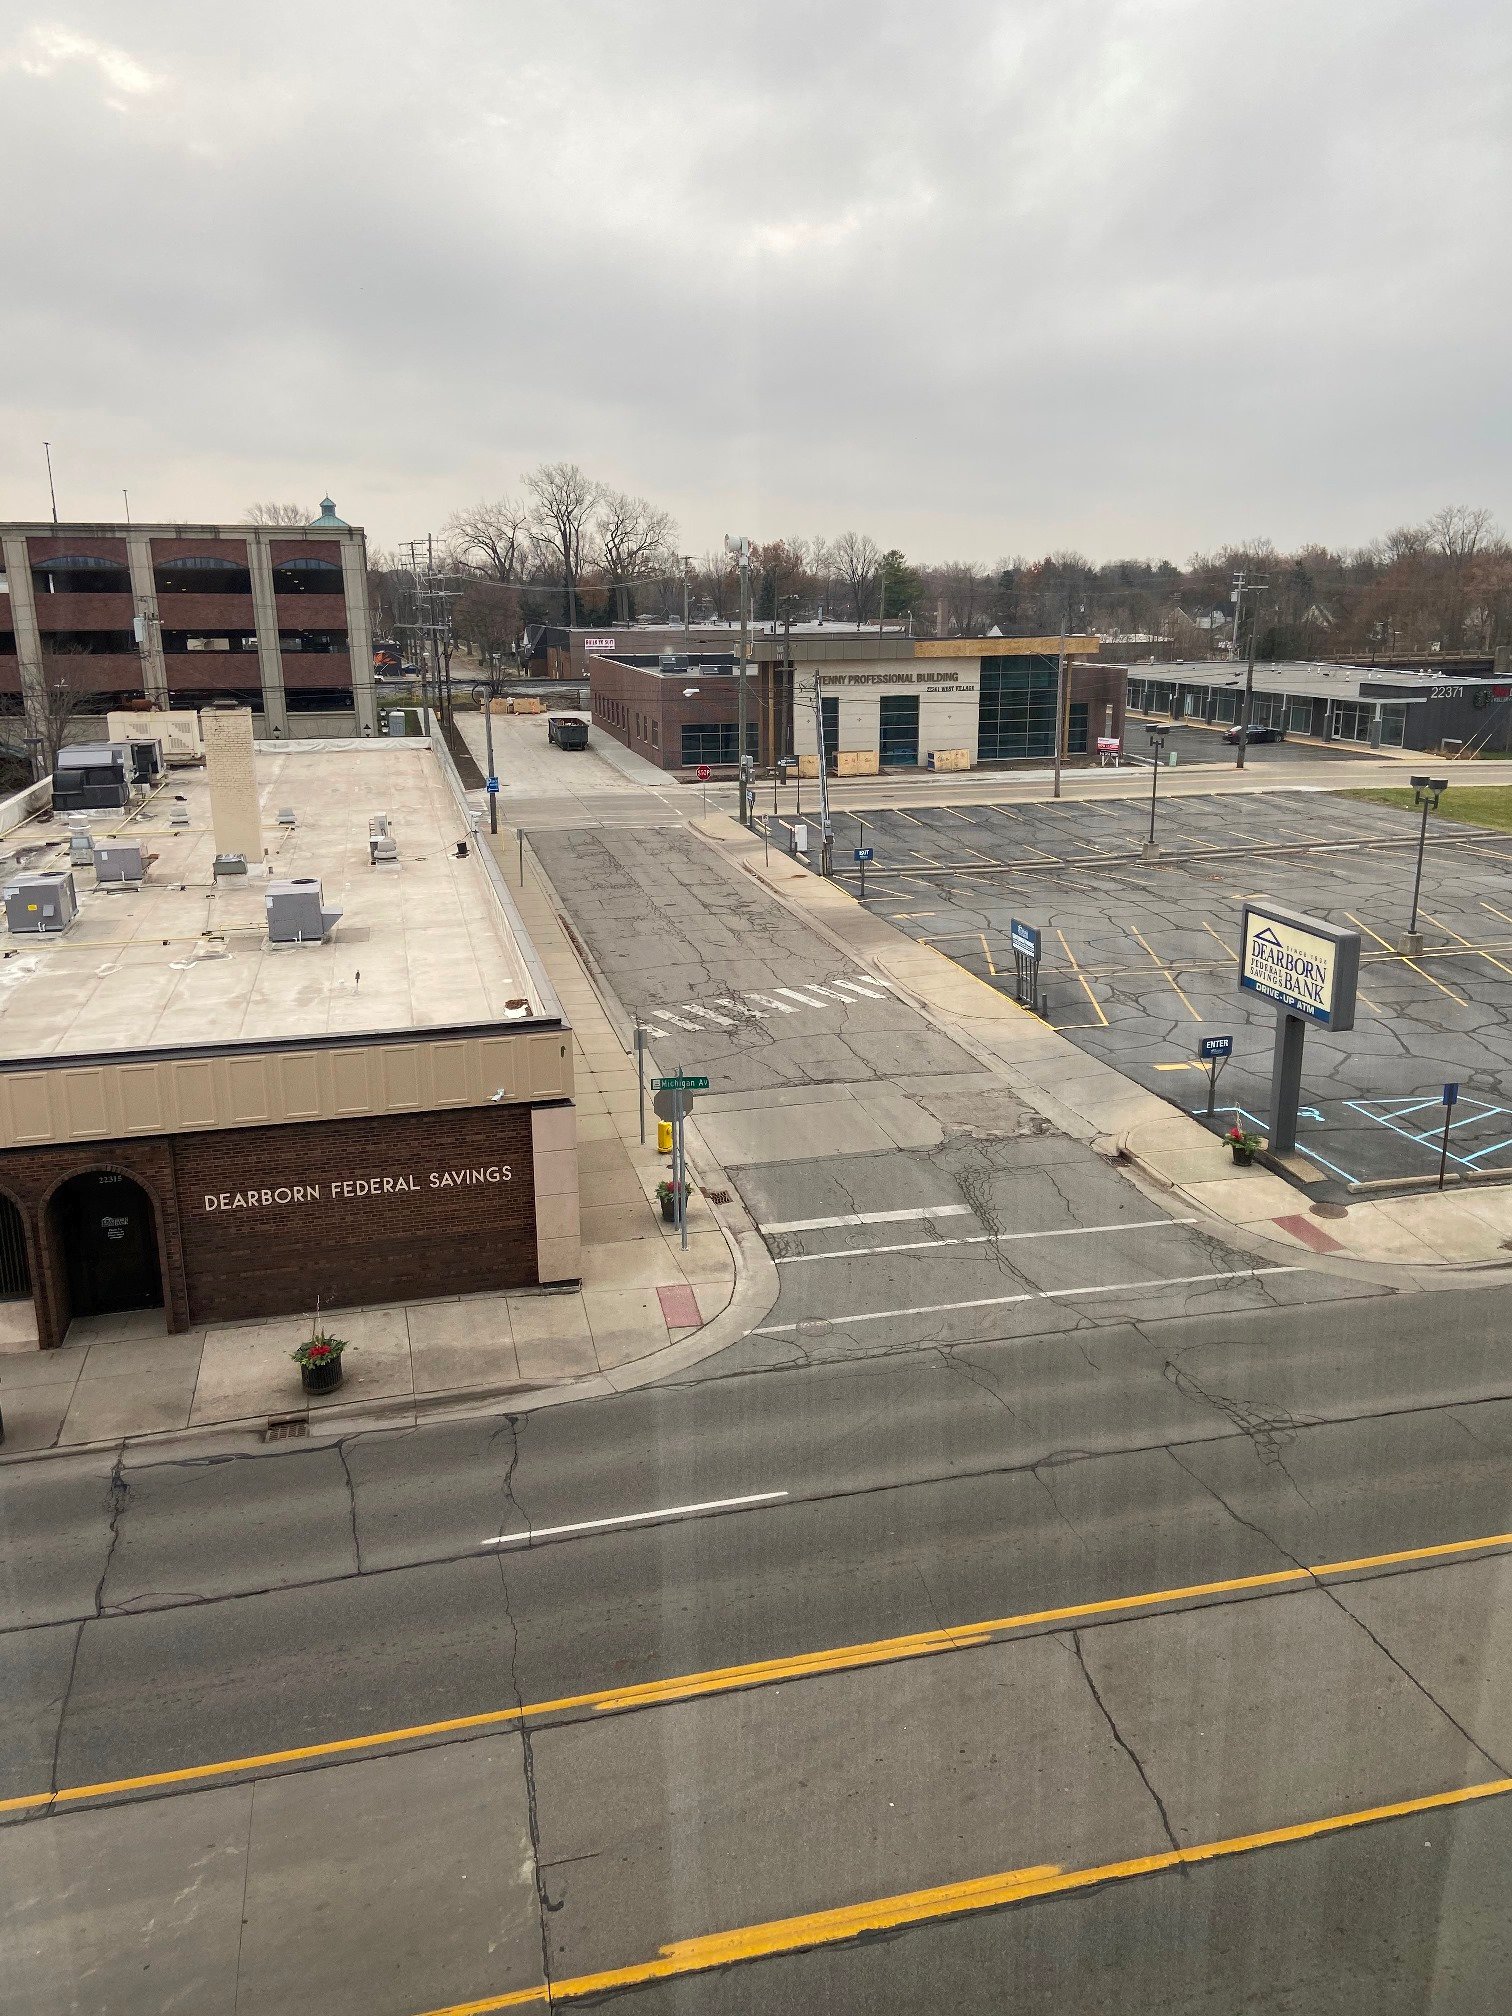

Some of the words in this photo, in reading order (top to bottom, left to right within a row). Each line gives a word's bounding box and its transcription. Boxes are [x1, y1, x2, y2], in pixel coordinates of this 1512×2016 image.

[848, 673, 915, 685] PROFESSIONAL
[916, 672, 959, 683] BUILDING
[1430, 686, 1464, 699] 22371
[697, 769, 710, 777] STOP
[1286, 945, 1307, 958] SINCE
[1250, 957, 1283, 978] FEDERAL
[1251, 939, 1327, 985] DEARBORN
[1250, 966, 1283, 988] SAVINGS
[1283, 971, 1325, 1006] BANK
[1255, 982, 1295, 1005] DRIVE-UP
[1296, 1001, 1316, 1015] ATM
[1206, 1039, 1229, 1049] ENTER
[661, 1079, 695, 1090] Michigan
[698, 1079, 708, 1087] Av
[204, 1184, 320, 1212] DEARBORN
[331, 1174, 421, 1199] FEDERAL
[429, 1165, 512, 1189] SAVINGS
